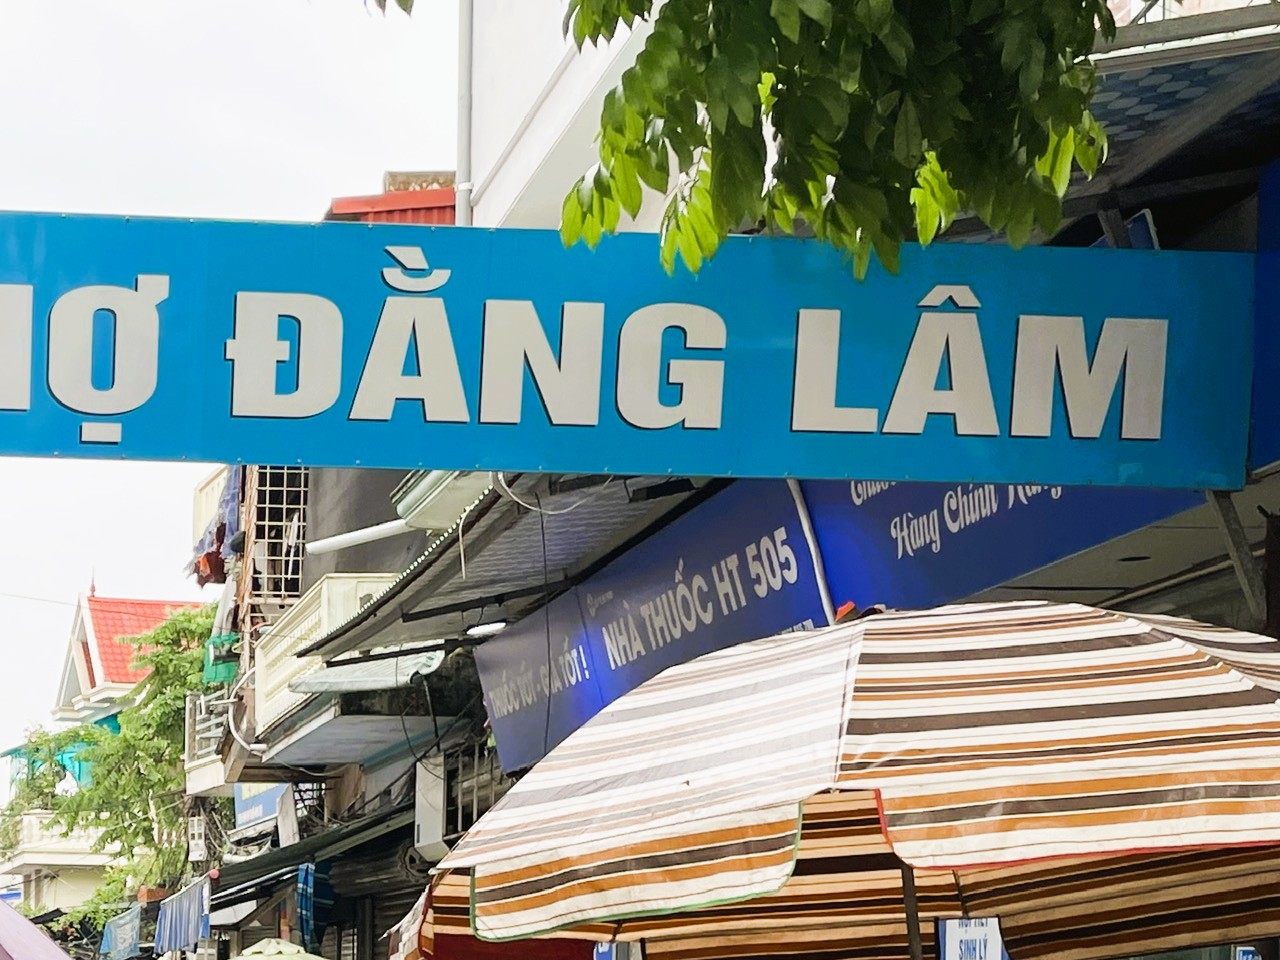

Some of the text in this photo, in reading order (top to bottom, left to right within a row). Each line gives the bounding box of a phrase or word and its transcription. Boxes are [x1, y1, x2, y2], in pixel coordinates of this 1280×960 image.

[226, 245, 728, 430] ĐẰNG
[792, 284, 1168, 440] LÂM
[602, 526, 798, 670] NHÀ THUỐC HT 505
[890, 511, 941, 560] Hàng
